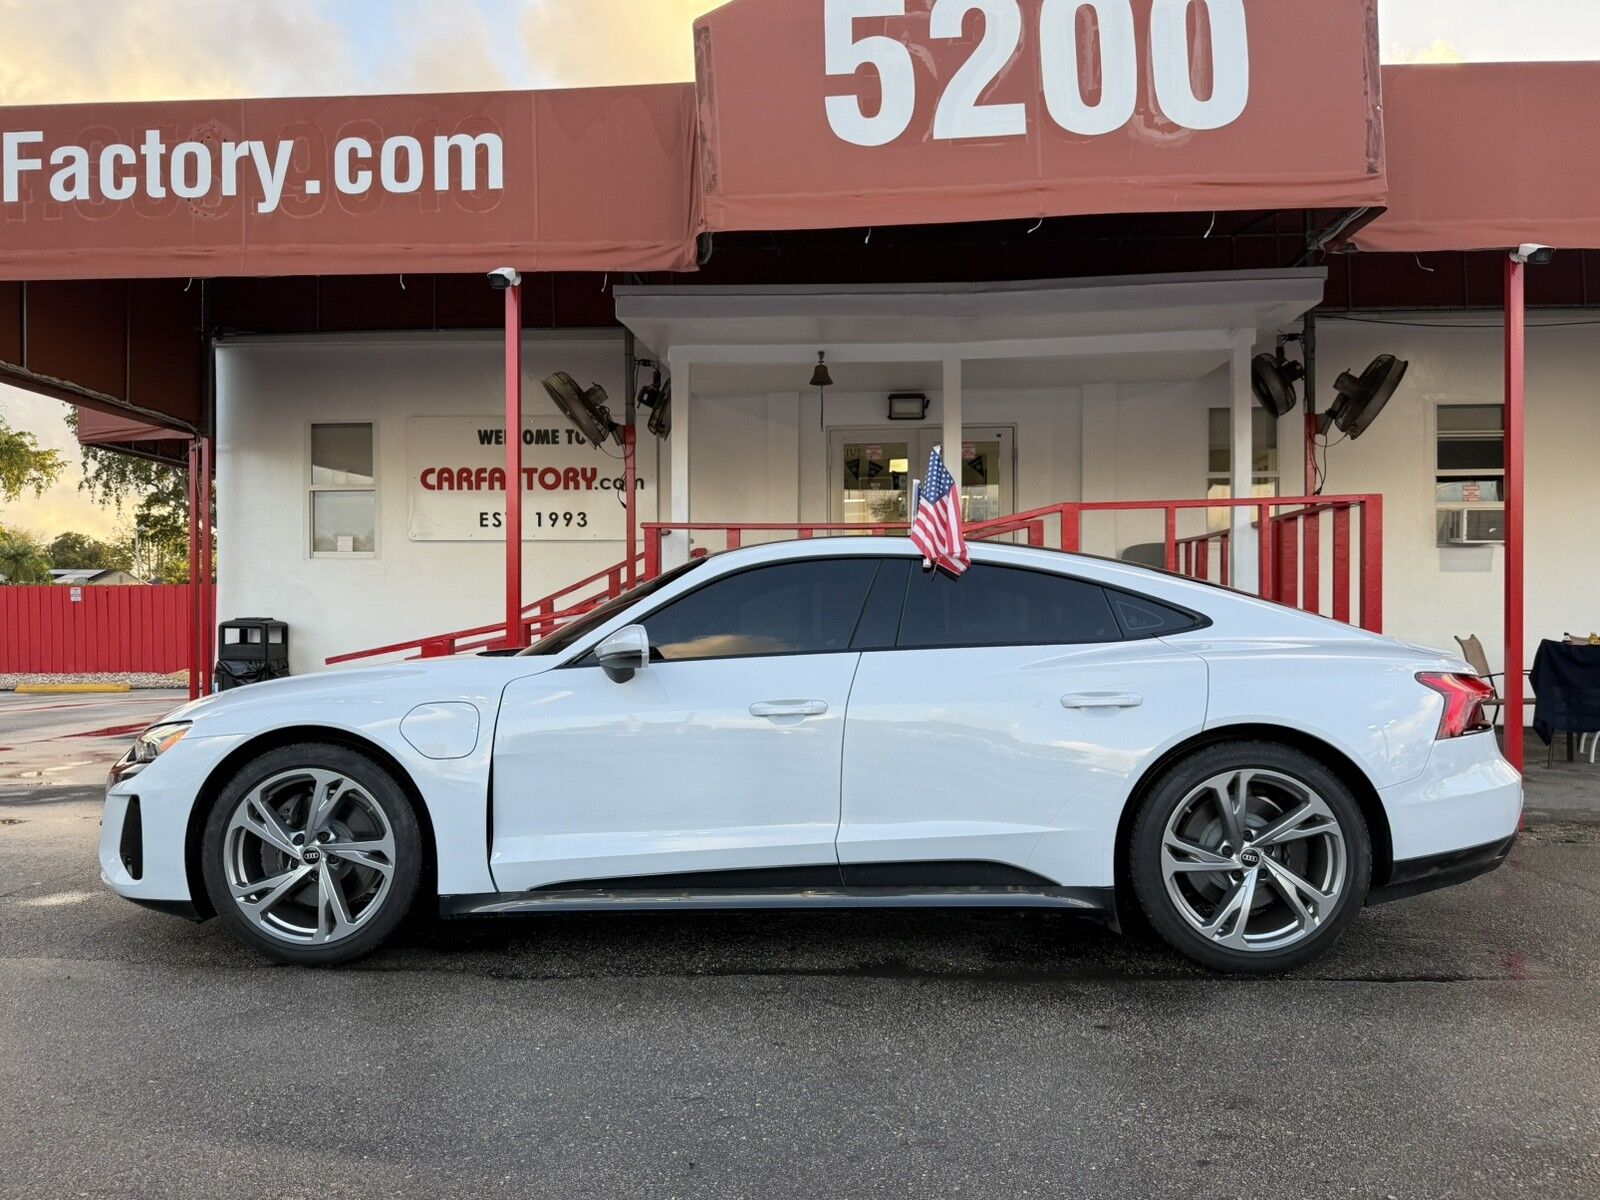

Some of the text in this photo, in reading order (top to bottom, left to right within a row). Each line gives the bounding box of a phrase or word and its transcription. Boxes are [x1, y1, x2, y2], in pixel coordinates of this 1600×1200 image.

[824, 0, 1250, 146] 5200
[2, 129, 504, 214] Factory.com
[477, 428, 560, 446] WEOME
[479, 511, 588, 528] ES 1993
